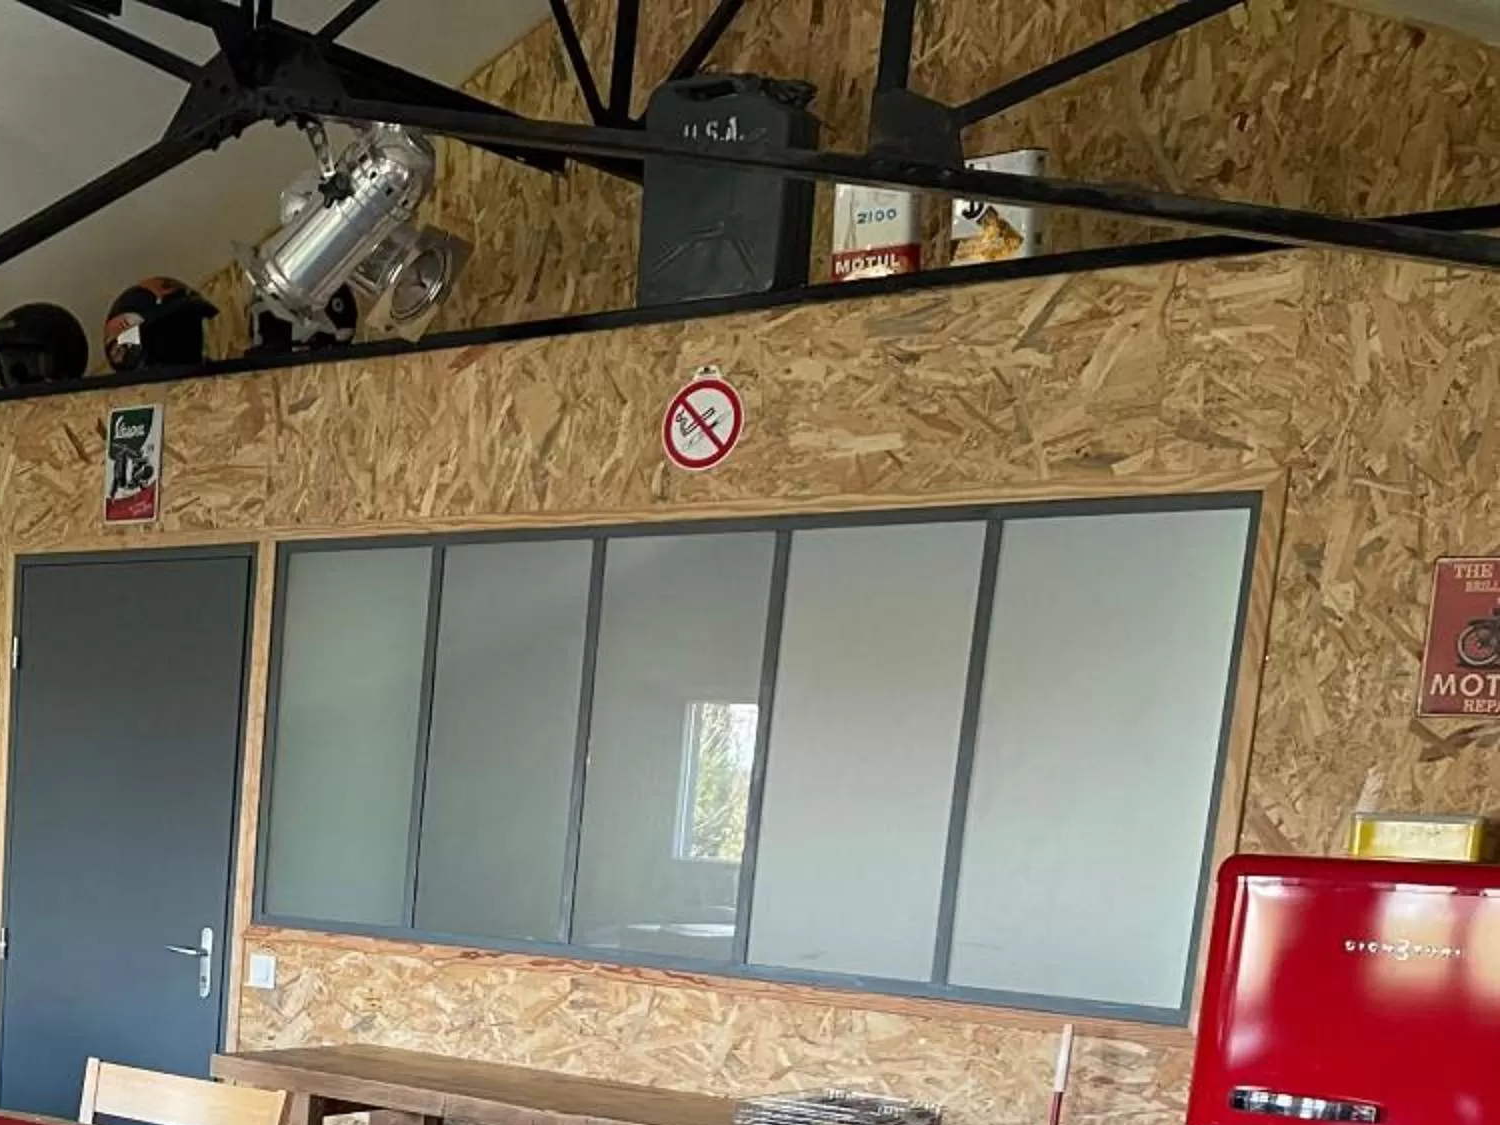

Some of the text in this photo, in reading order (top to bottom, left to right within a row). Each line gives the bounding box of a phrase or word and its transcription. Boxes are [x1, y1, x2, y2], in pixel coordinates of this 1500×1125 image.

[857, 208, 897, 224] 2100
[835, 253, 897, 274] MOTUL
[1454, 563, 1492, 578] THE
